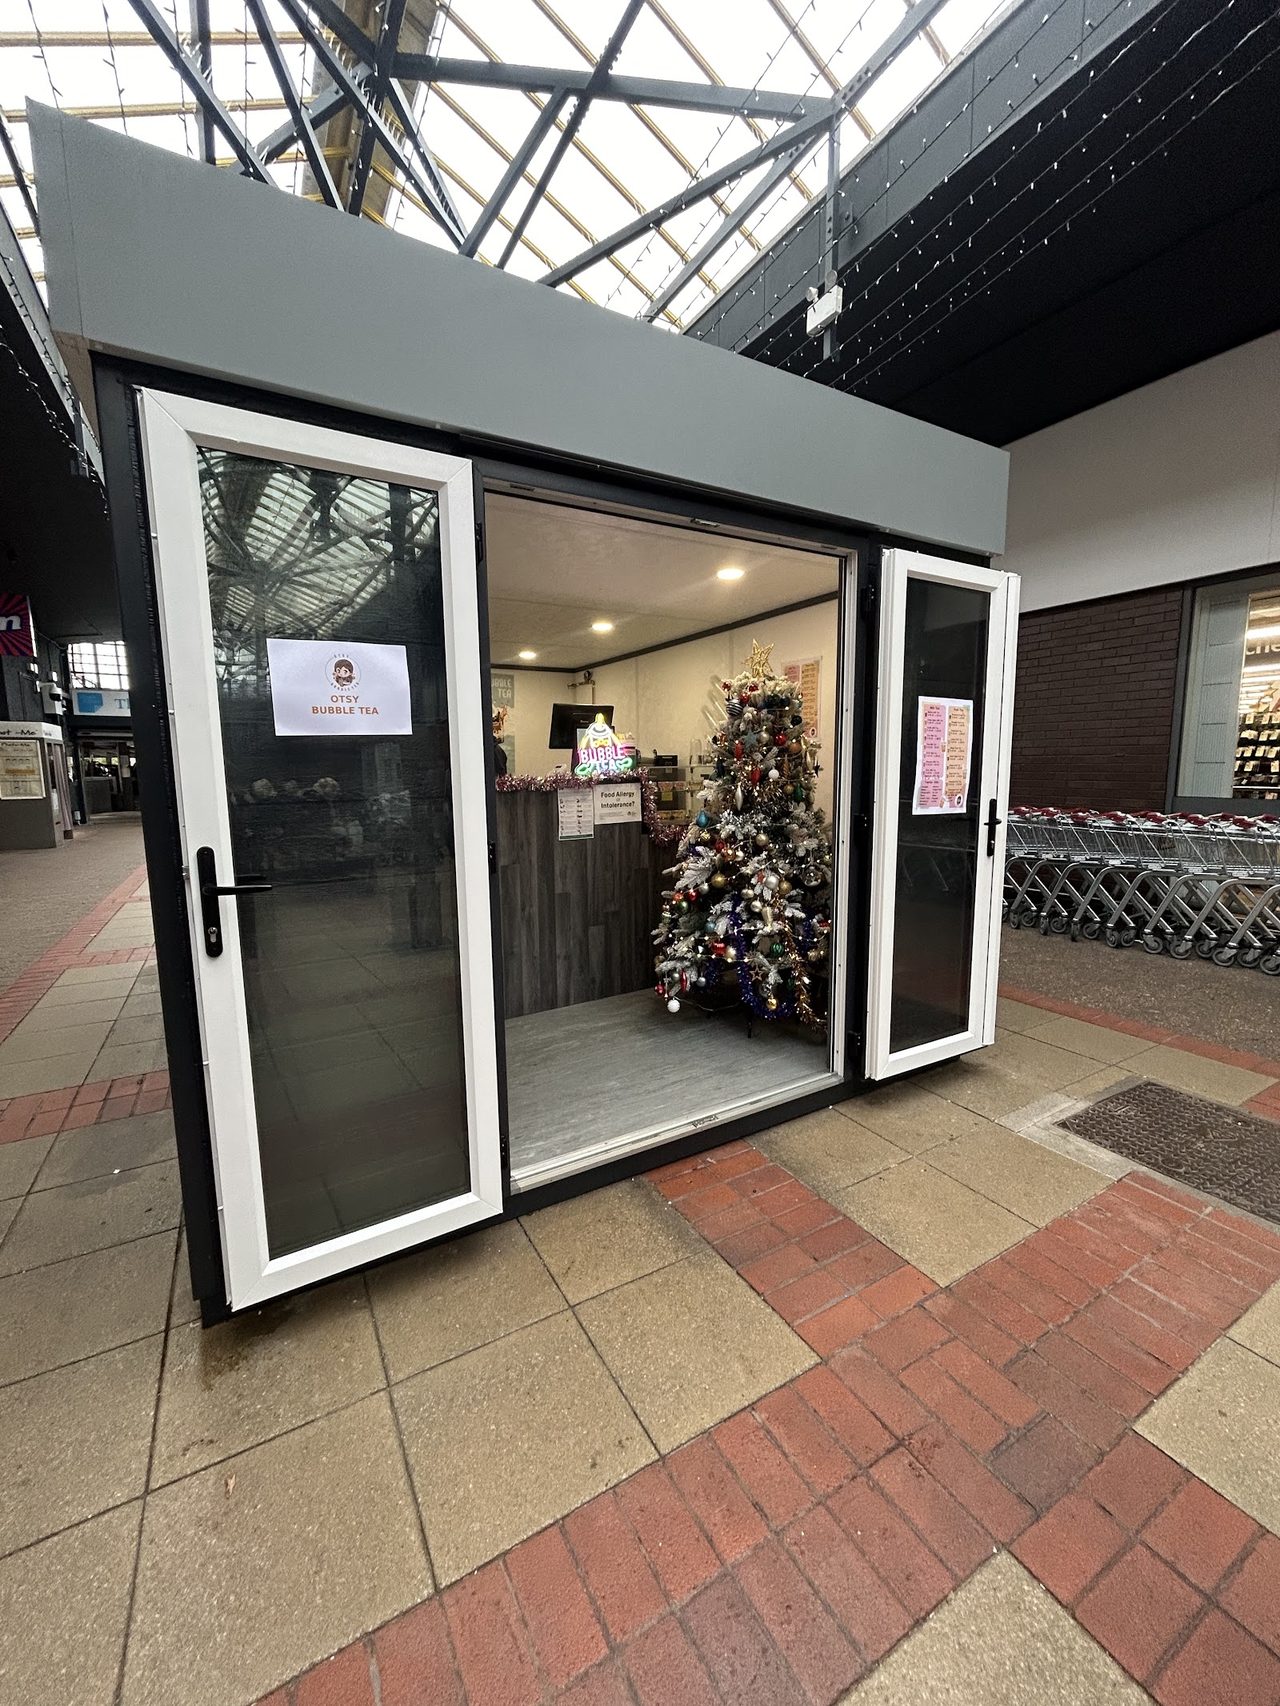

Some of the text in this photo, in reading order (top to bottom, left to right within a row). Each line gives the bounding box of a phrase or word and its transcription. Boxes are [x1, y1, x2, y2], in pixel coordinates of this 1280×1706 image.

[498, 688, 512, 698] TEA
[330, 695, 360, 703] OTSY
[312, 706, 379, 715] BUBBLE TEA
[579, 745, 625, 763] BUBBLE
[588, 759, 618, 774] TEA
